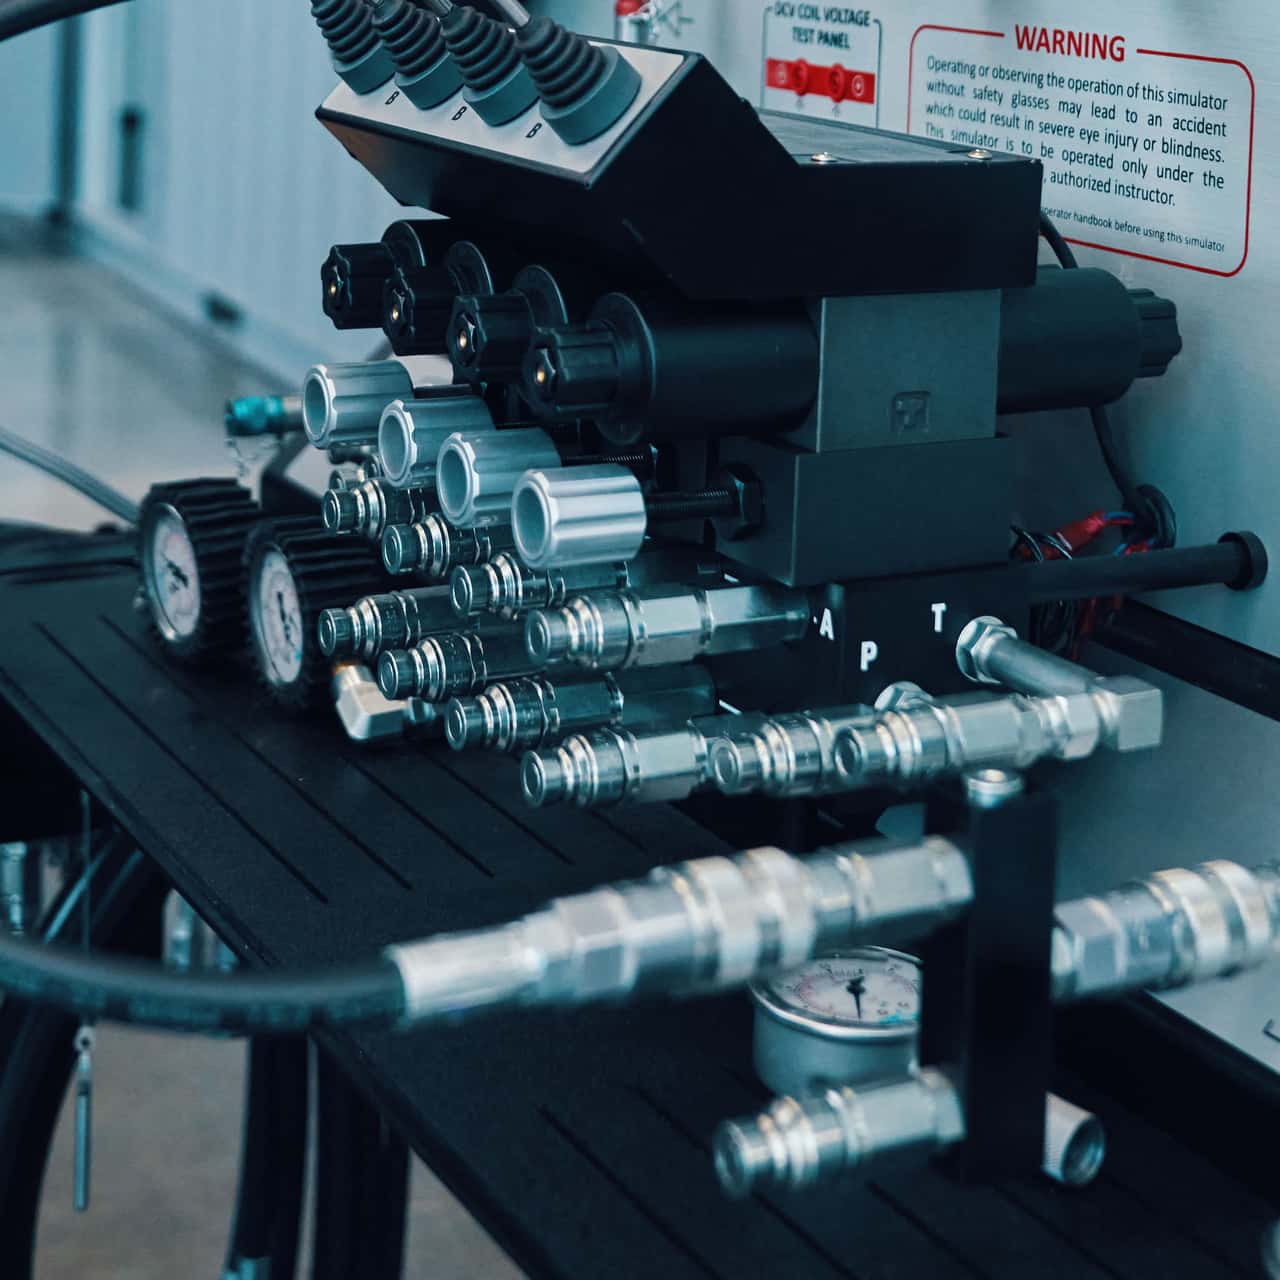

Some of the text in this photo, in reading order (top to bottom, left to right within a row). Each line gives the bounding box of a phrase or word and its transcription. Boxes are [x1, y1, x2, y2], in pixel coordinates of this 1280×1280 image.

[798, 3, 821, 21] COIL
[823, 7, 871, 27] VOLTAGE
[792, 26, 850, 49] TEST PANEL
[1015, 24, 1125, 62] WARNING
[385, 90, 400, 106] B
[927, 55, 1228, 111] Operating or observing the operation of this simulator
[452, 106, 467, 121] B
[926, 80, 1227, 137] without safety glasses may lead to an accident
[526, 122, 542, 138] B
[925, 102, 1225, 163] which could result in severe eye injury or blindness.
[925, 122, 1225, 189] This simulator is to be operated only under the
[1050, 170, 1176, 207] authorized instructor.
[1073, 211, 1112, 229] handbook
[1115, 220, 1142, 236] before
[1142, 227, 1165, 242] using
[1166, 230, 1182, 244] this
[819, 607, 835, 641] A
[931, 602, 947, 632] T
[860, 640, 879, 671] P
